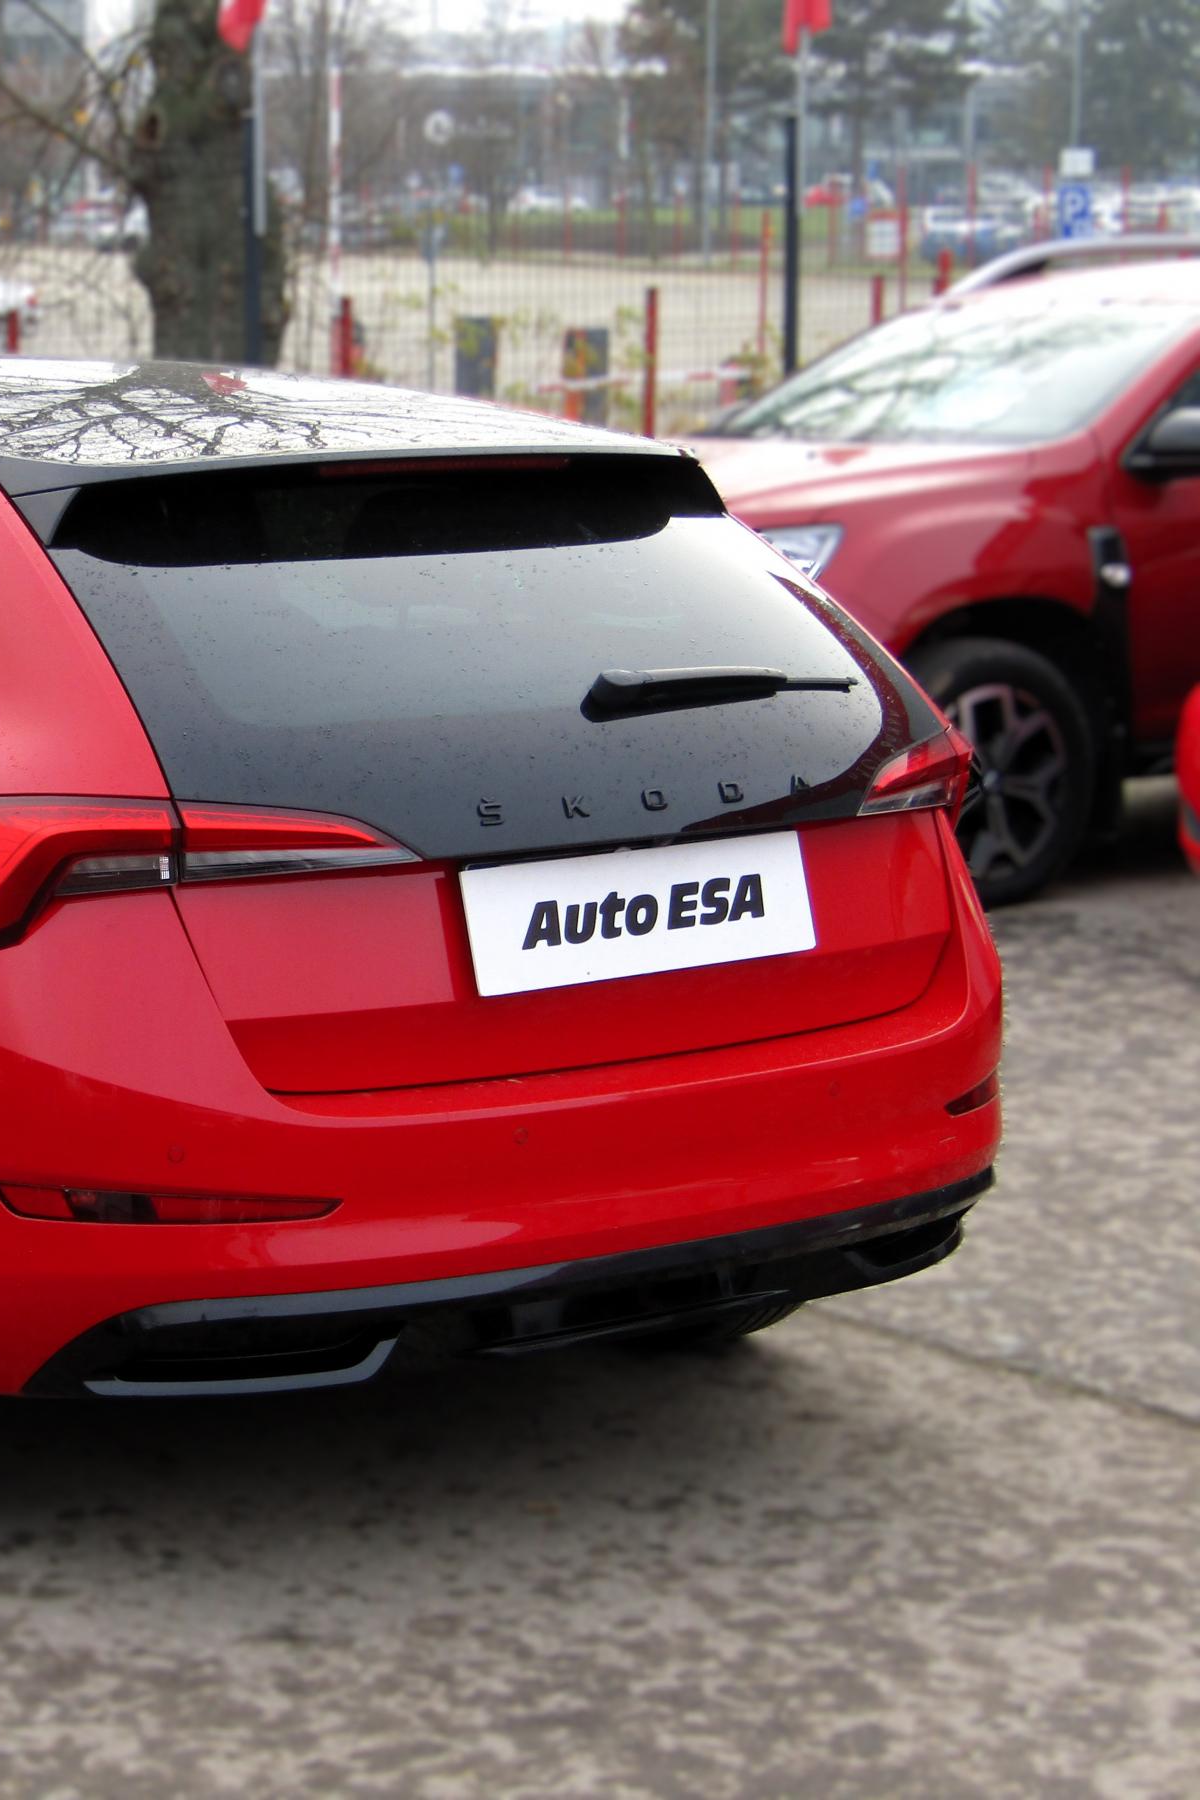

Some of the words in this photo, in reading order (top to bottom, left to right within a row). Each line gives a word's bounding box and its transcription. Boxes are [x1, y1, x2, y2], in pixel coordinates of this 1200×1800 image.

[1065, 191, 1085, 221] P
[522, 891, 658, 950] Auto
[667, 873, 765, 930] ESA
